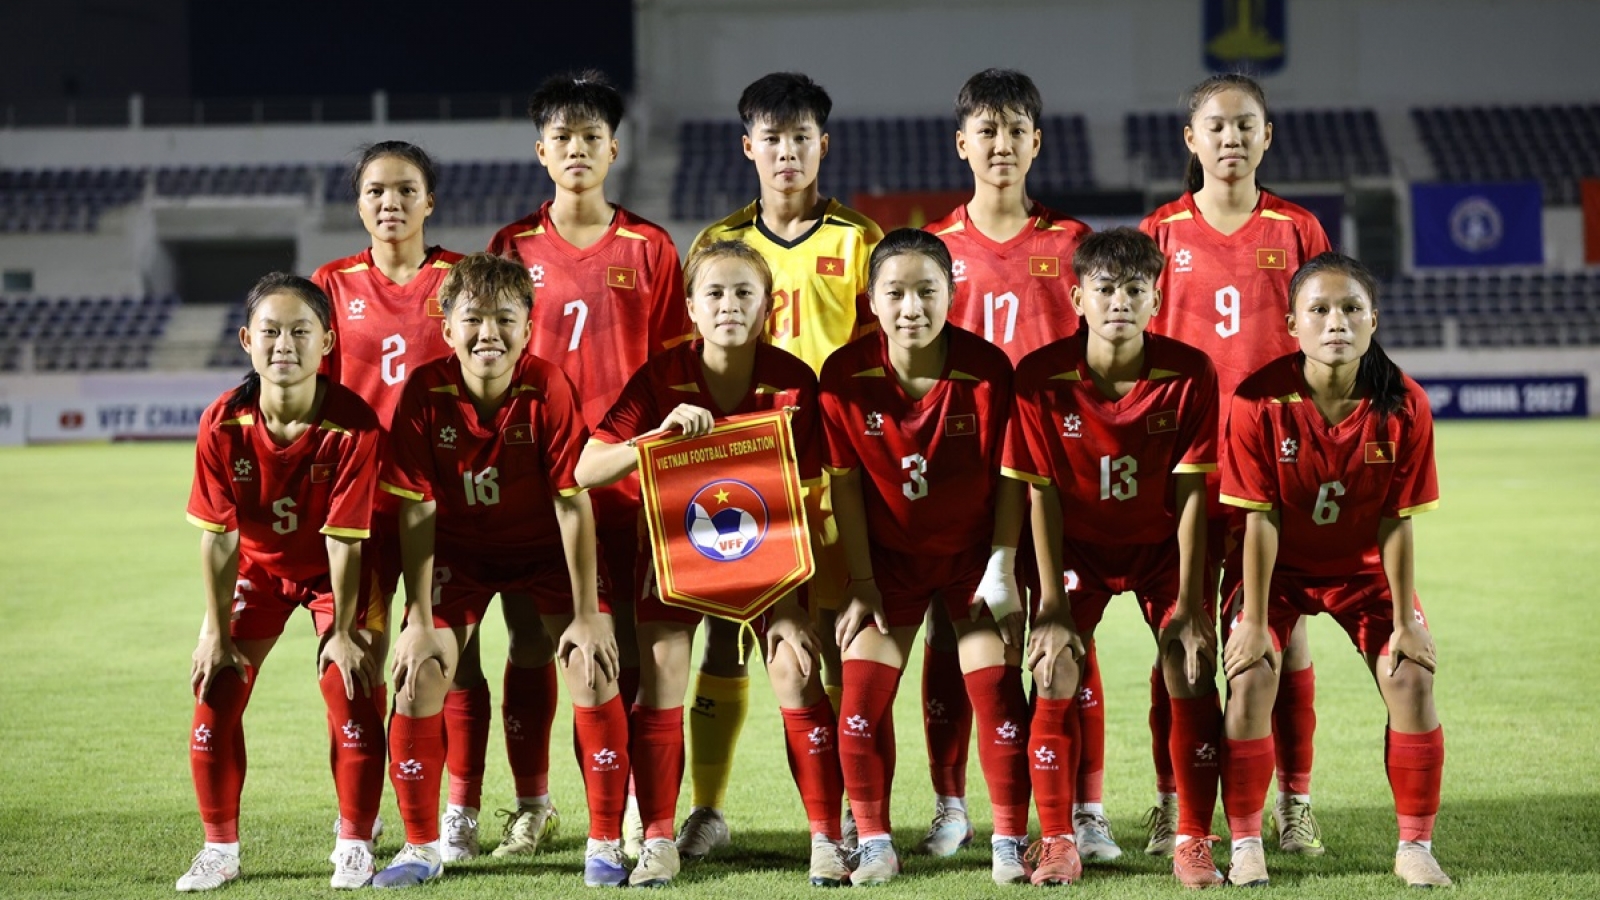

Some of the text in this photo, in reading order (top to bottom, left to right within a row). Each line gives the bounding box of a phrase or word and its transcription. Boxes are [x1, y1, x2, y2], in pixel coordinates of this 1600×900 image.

[564, 299, 588, 351] 7
[771, 289, 800, 339] 21
[983, 290, 1019, 344] 17
[1215, 285, 1240, 338] 9
[381, 333, 406, 386] 2
[97, 406, 138, 428] VFF
[1459, 385, 1519, 413] CHINA
[1524, 383, 1576, 413] 2027
[656, 436, 775, 471] VIETNAM FOOTBALL FEDERATION
[463, 466, 500, 506] 18
[901, 453, 928, 500] 3
[1100, 455, 1138, 501] 13
[272, 496, 298, 535] 5
[1312, 481, 1346, 526] 6
[719, 538, 743, 551] VFF
